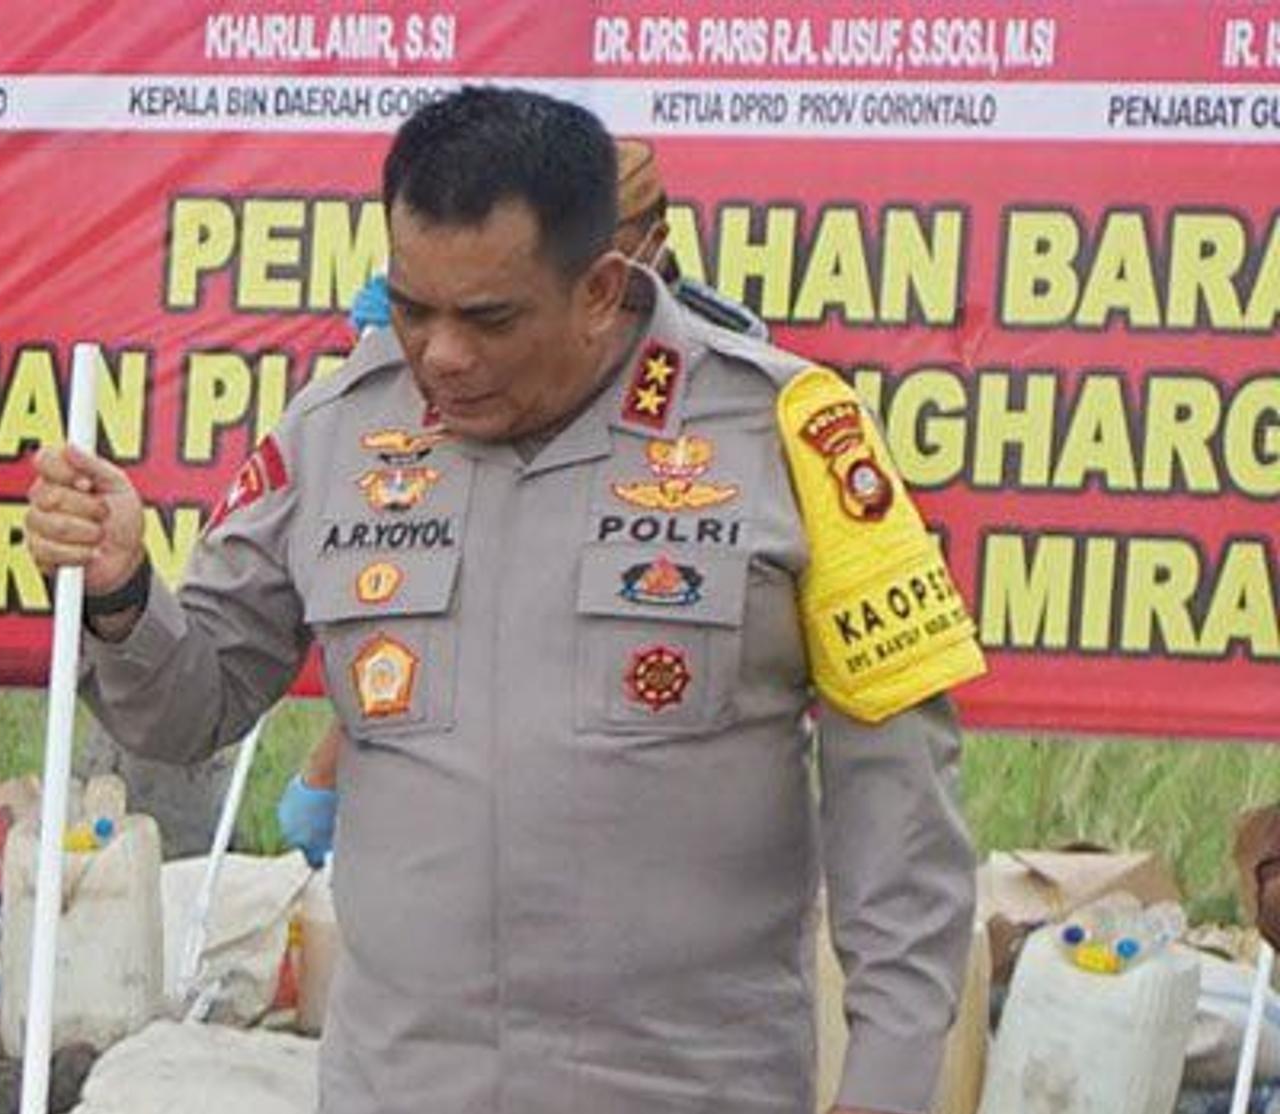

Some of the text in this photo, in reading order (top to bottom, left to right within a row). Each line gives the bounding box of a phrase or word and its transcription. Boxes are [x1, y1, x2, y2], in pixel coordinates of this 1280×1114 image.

[205, 15, 322, 60] KHAIRUL
[325, 15, 398, 67] AMIR,
[593, 17, 635, 64] DR.
[639, 17, 692, 65] DRS.
[697, 17, 770, 65] PARIS
[772, 17, 816, 65] R.A.
[821, 17, 904, 72] JUSUF,
[128, 85, 219, 116] KEPALA
[225, 86, 267, 116] BIN
[273, 87, 371, 117] DAERAH
[651, 91, 998, 127] KETUA DPRD PROV GORONTALO
[1107, 95, 1245, 128] PENJABAT
[598, 515, 741, 546] POLRI
